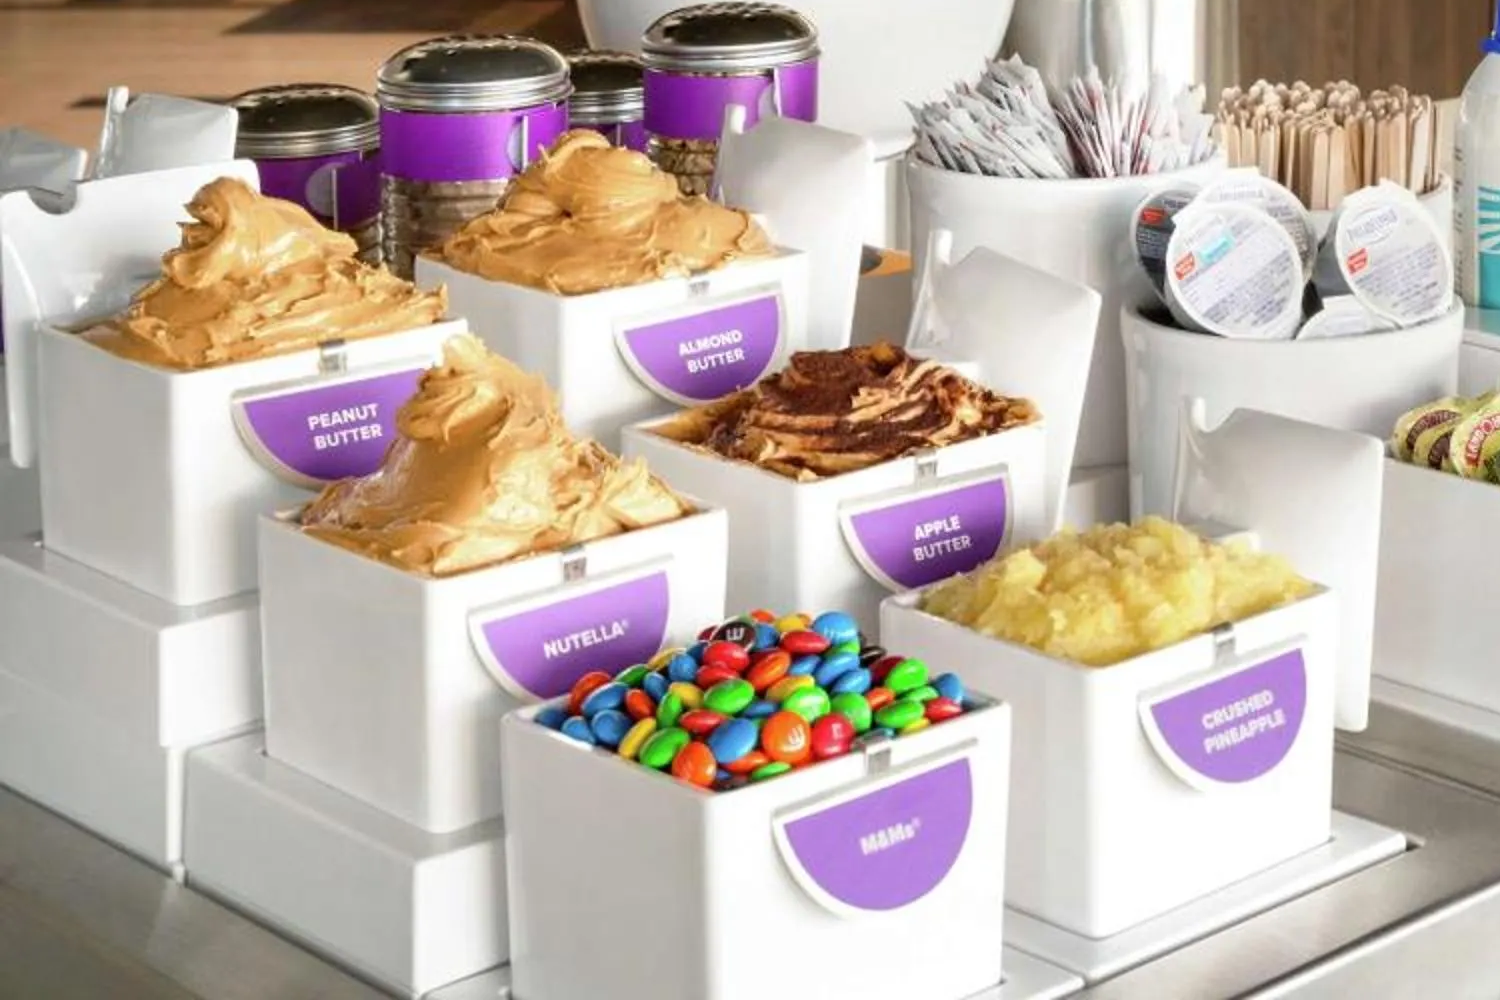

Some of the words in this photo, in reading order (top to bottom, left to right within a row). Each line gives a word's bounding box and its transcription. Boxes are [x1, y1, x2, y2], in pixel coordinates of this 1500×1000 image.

[678, 329, 744, 357] ALMOND
[687, 347, 745, 374] BUTTER
[306, 402, 380, 431] PEANUT
[313, 423, 384, 450] BUTTER
[914, 515, 962, 541] APPLE
[912, 535, 973, 562] BUTTER
[1201, 689, 1274, 730] CRUSHED
[1203, 708, 1287, 754] PINEAPPLE
